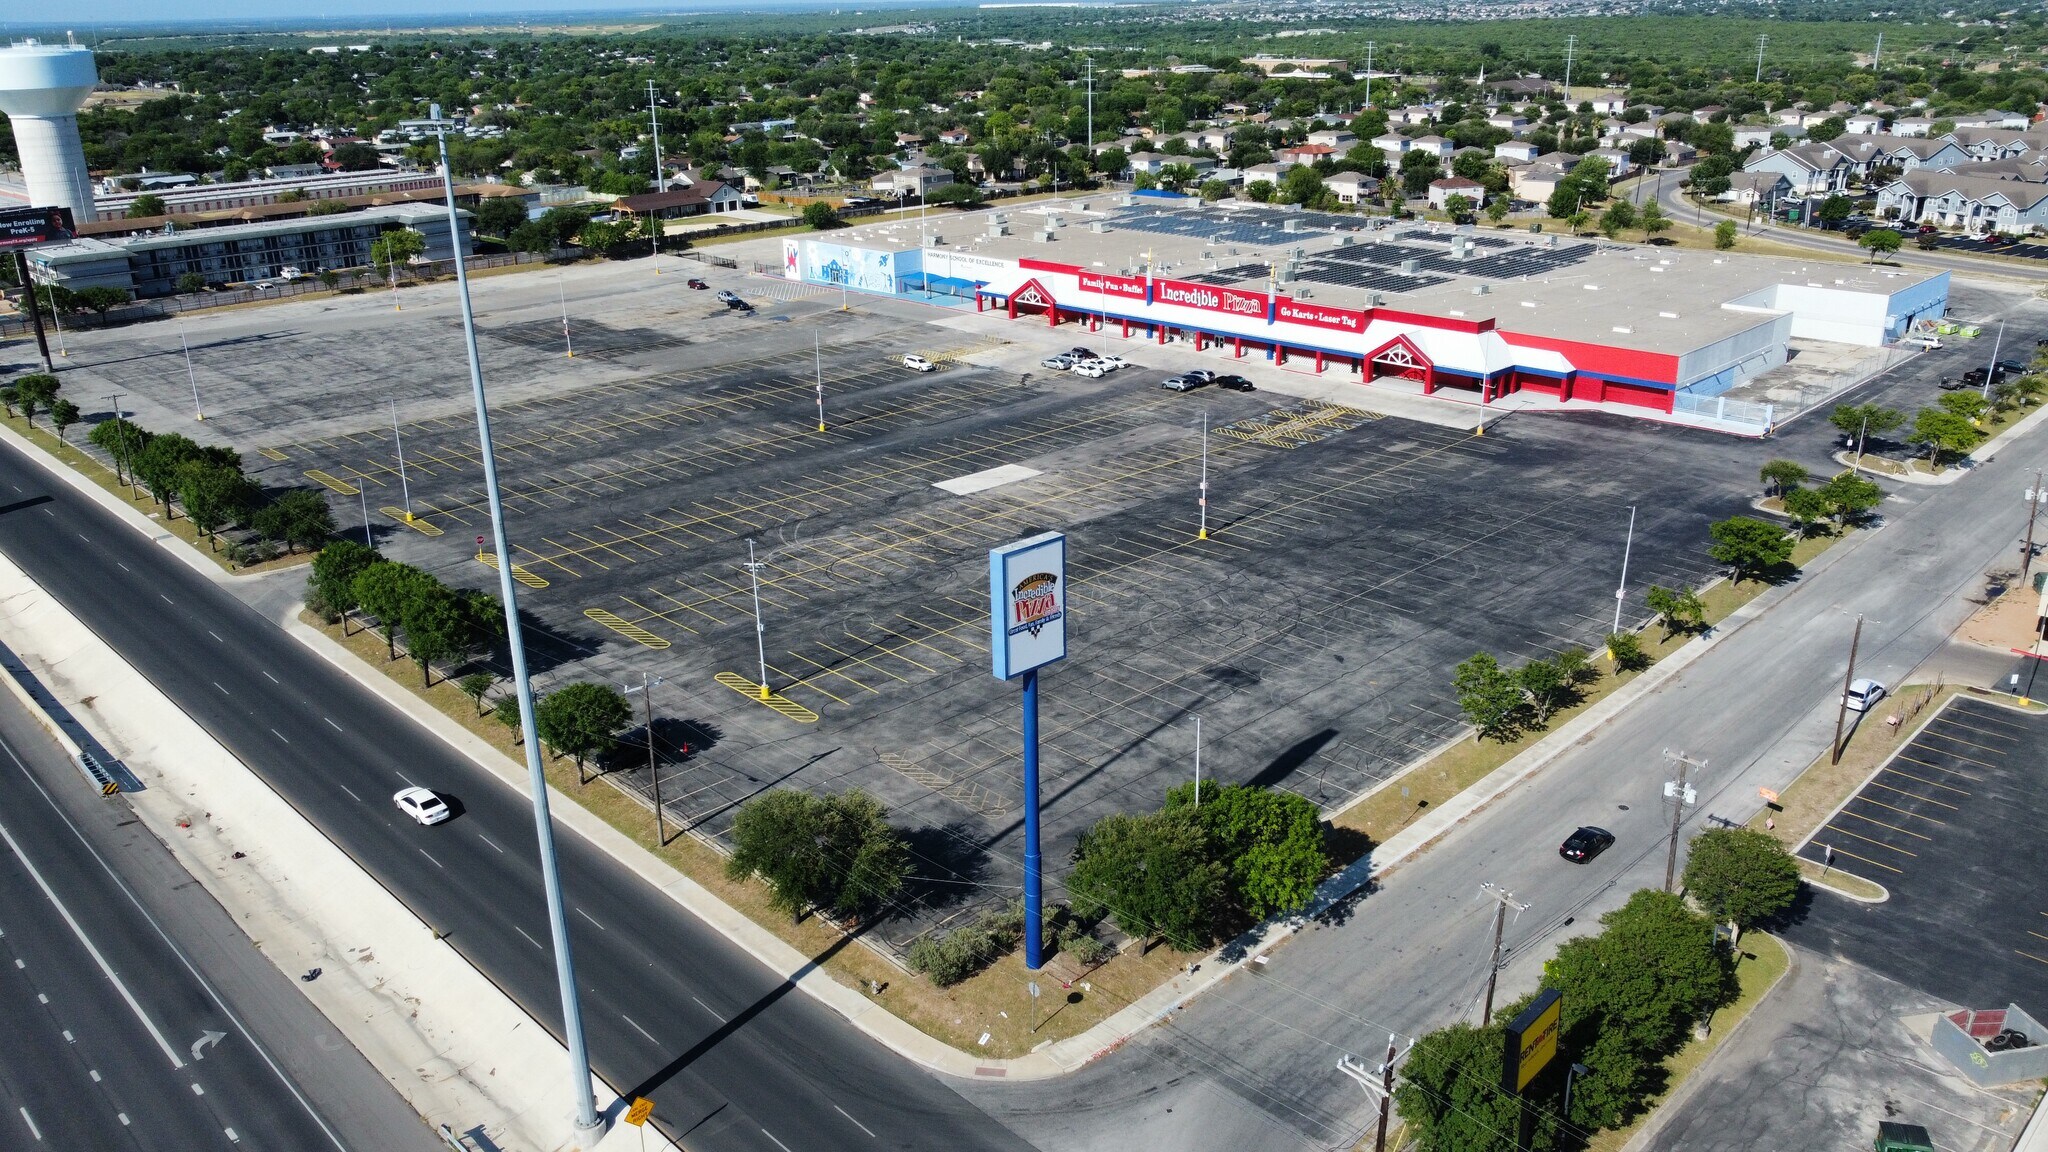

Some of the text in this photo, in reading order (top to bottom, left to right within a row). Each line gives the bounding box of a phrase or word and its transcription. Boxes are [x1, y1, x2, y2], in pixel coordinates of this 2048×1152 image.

[10, 226, 35, 235] PreK-5
[13, 219, 45, 227] Enrolling
[927, 252, 949, 260] HARMONY
[949, 255, 967, 263] SCHOOL
[976, 258, 1005, 269] EXCELLENCE
[1082, 277, 1143, 294] Family Fun Buffet
[1160, 282, 1262, 314] Incredible Pizza
[1280, 306, 1357, 328] Go Karts Laser Tag
[1019, 573, 1053, 588] AMERICA'S
[1014, 580, 1055, 602] Incredible
[1014, 593, 1056, 623] Pizza
